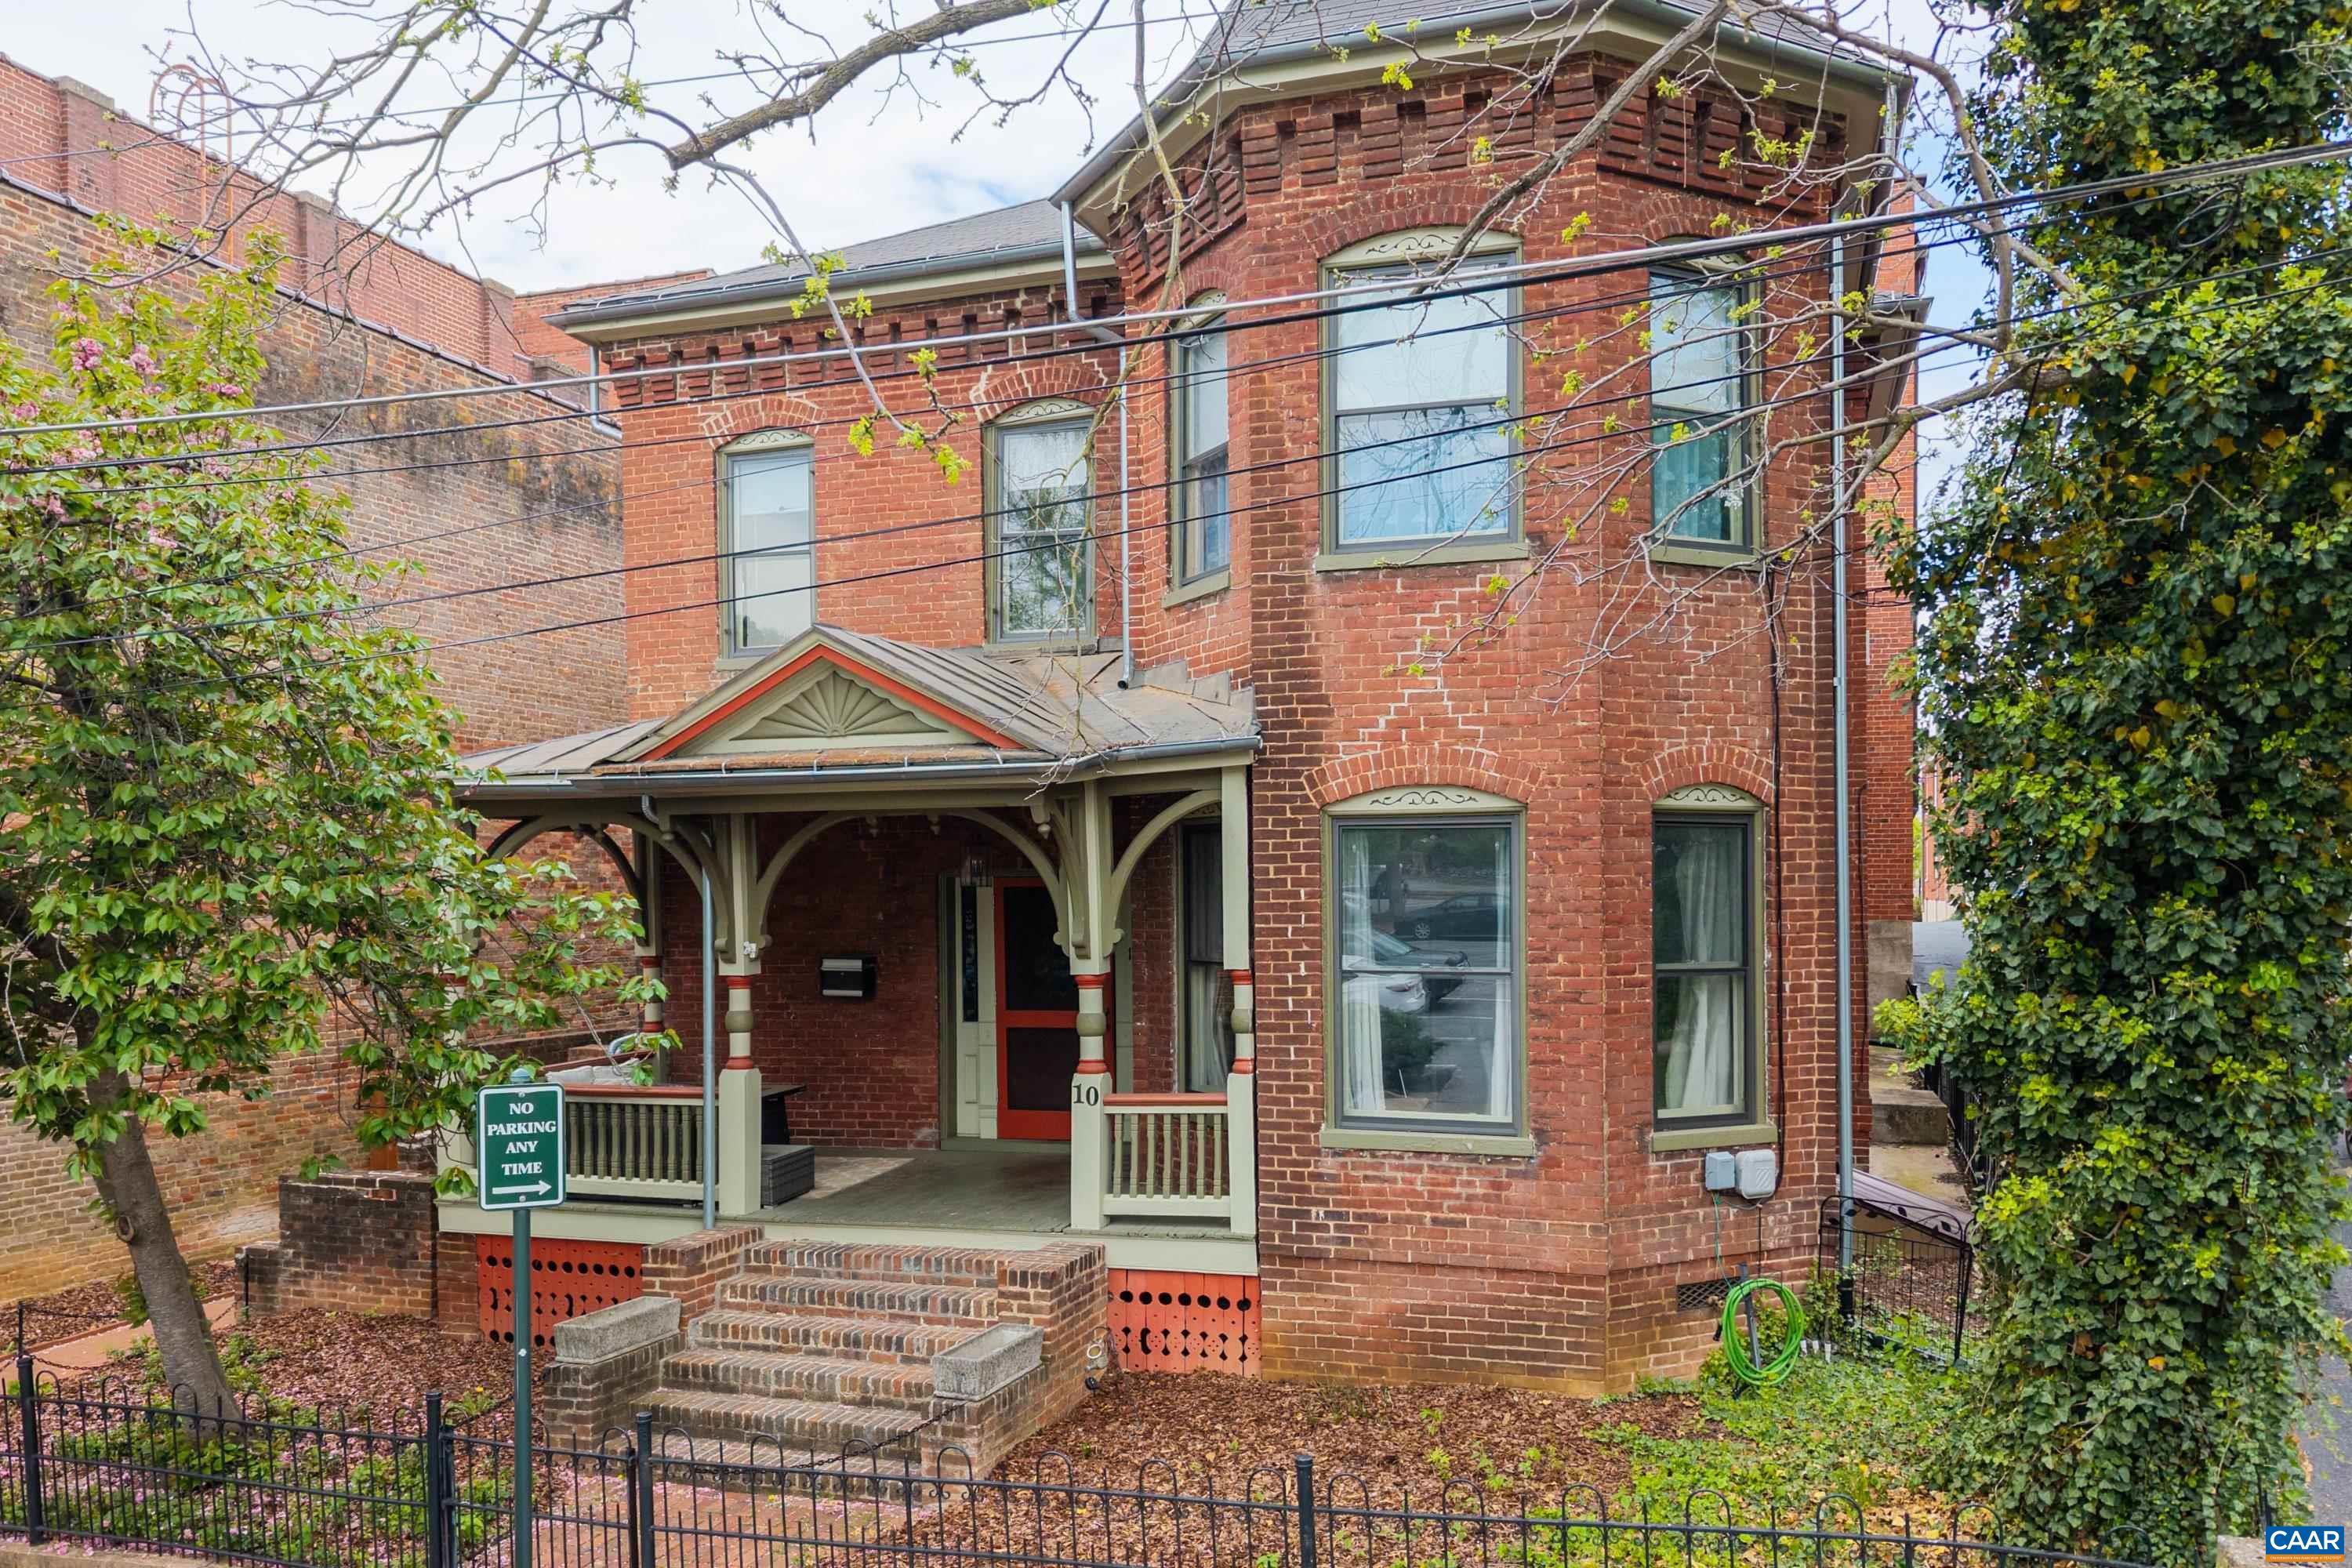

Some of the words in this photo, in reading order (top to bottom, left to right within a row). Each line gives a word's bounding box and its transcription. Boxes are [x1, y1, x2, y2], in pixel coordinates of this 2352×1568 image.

[1073, 1083, 1099, 1106] 10
[509, 1102, 534, 1115] NO
[487, 1120, 557, 1136] PARKING
[505, 1141, 539, 1154] ANY
[501, 1162, 543, 1176] TIME
